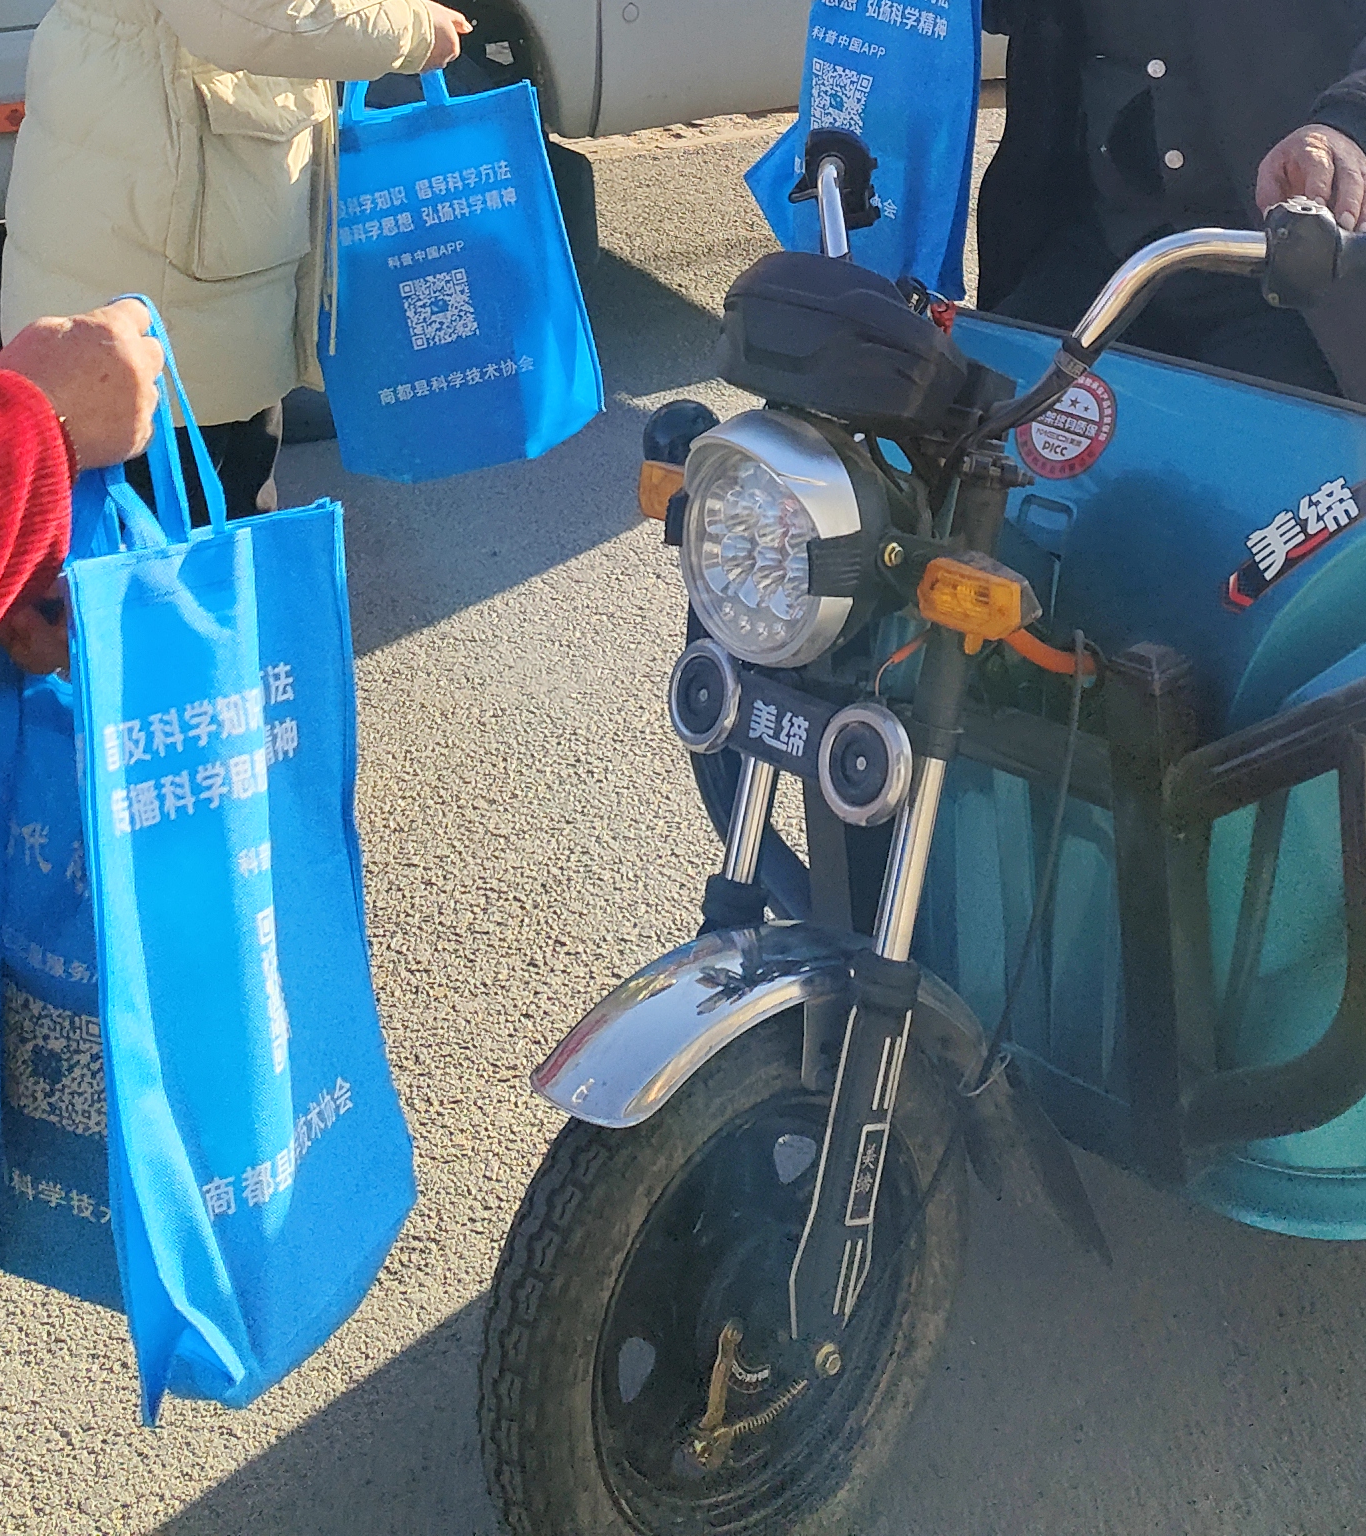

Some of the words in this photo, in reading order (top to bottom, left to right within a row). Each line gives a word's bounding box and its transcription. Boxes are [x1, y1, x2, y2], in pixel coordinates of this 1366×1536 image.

[811, 25, 886, 59] 科普中国APP
[414, 159, 512, 201] 倡导科学方法
[420, 186, 518, 227] 弘扬科学精神
[377, 354, 536, 406] 商都县科学技术协会
[1245, 476, 1360, 582] 美缔
[748, 699, 810, 757] 美缔
